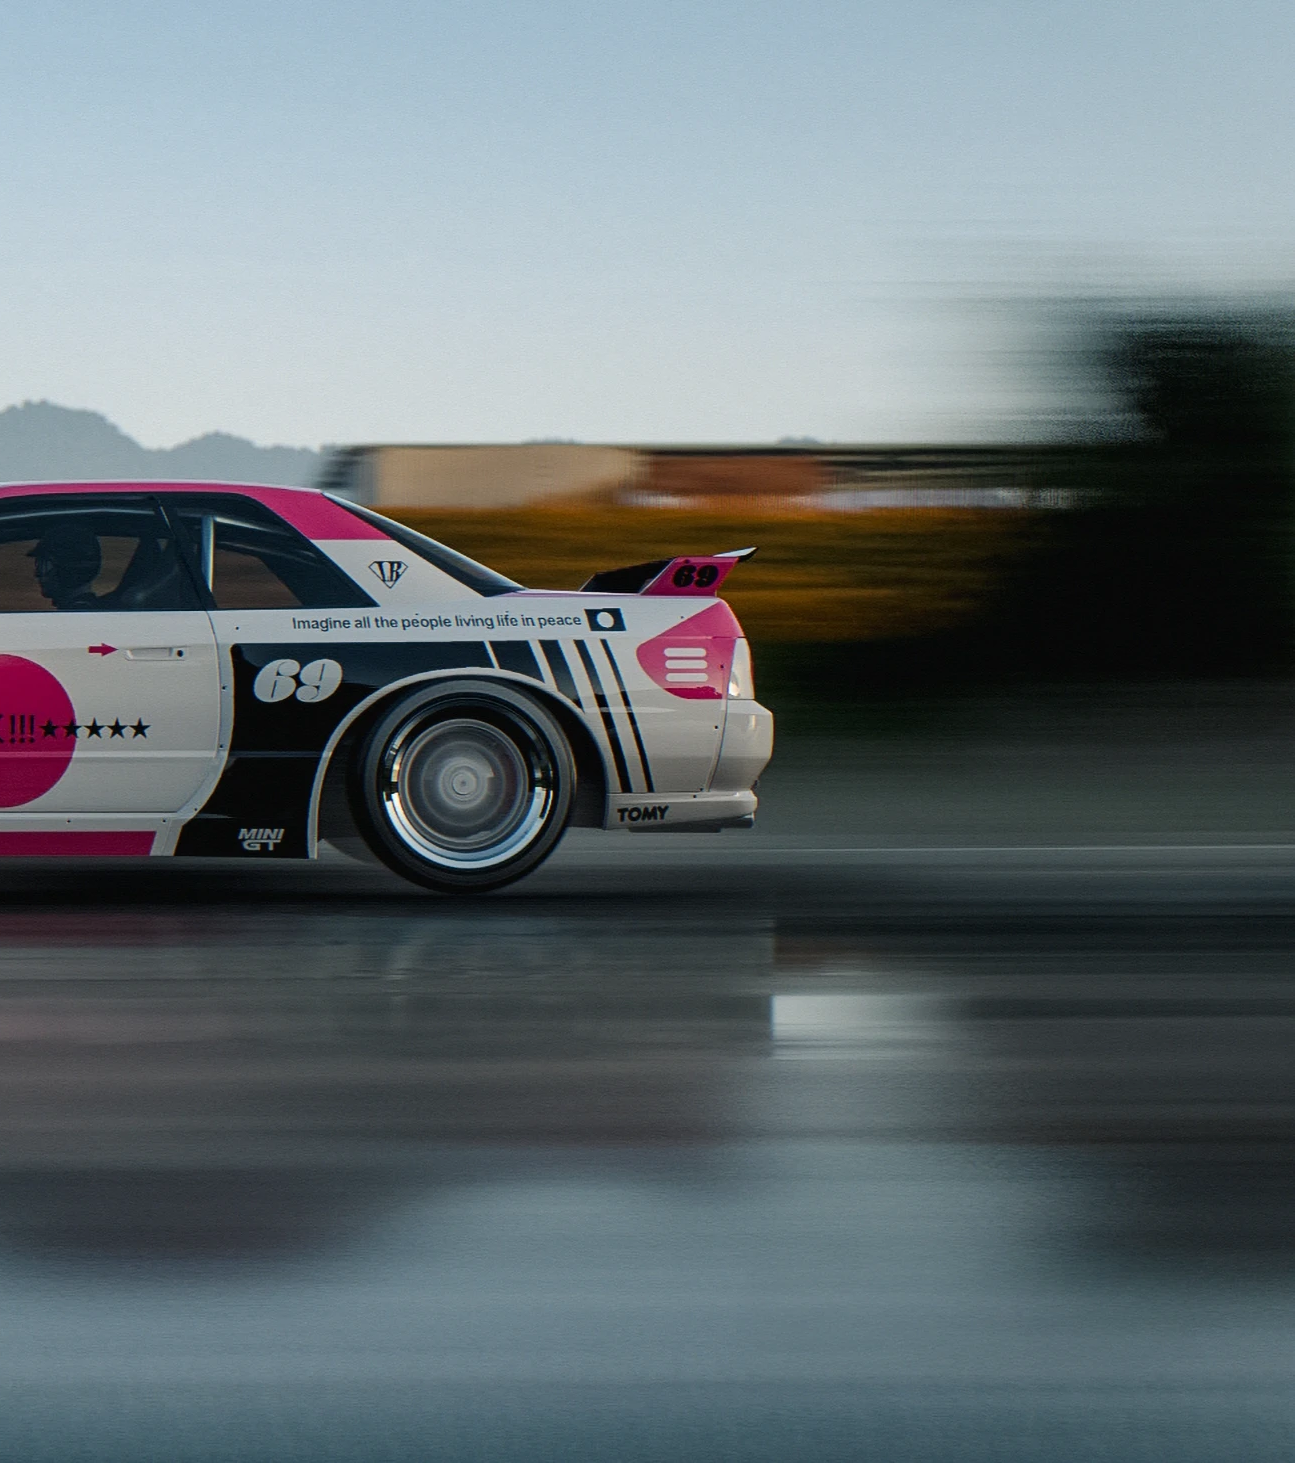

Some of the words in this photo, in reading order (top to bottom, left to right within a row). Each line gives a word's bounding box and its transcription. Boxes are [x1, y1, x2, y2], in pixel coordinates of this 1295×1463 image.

[673, 564, 720, 588] 69
[292, 617, 351, 632] Imagine
[354, 616, 372, 629] all
[374, 616, 398, 628] the
[401, 615, 452, 630] people
[455, 614, 495, 630] living
[496, 614, 519, 627] life
[520, 614, 536, 627] in
[537, 615, 582, 629] peace
[253, 658, 344, 703] 69
[616, 805, 670, 823] TOMY
[237, 828, 285, 840] MINI
[242, 839, 282, 851] GT
